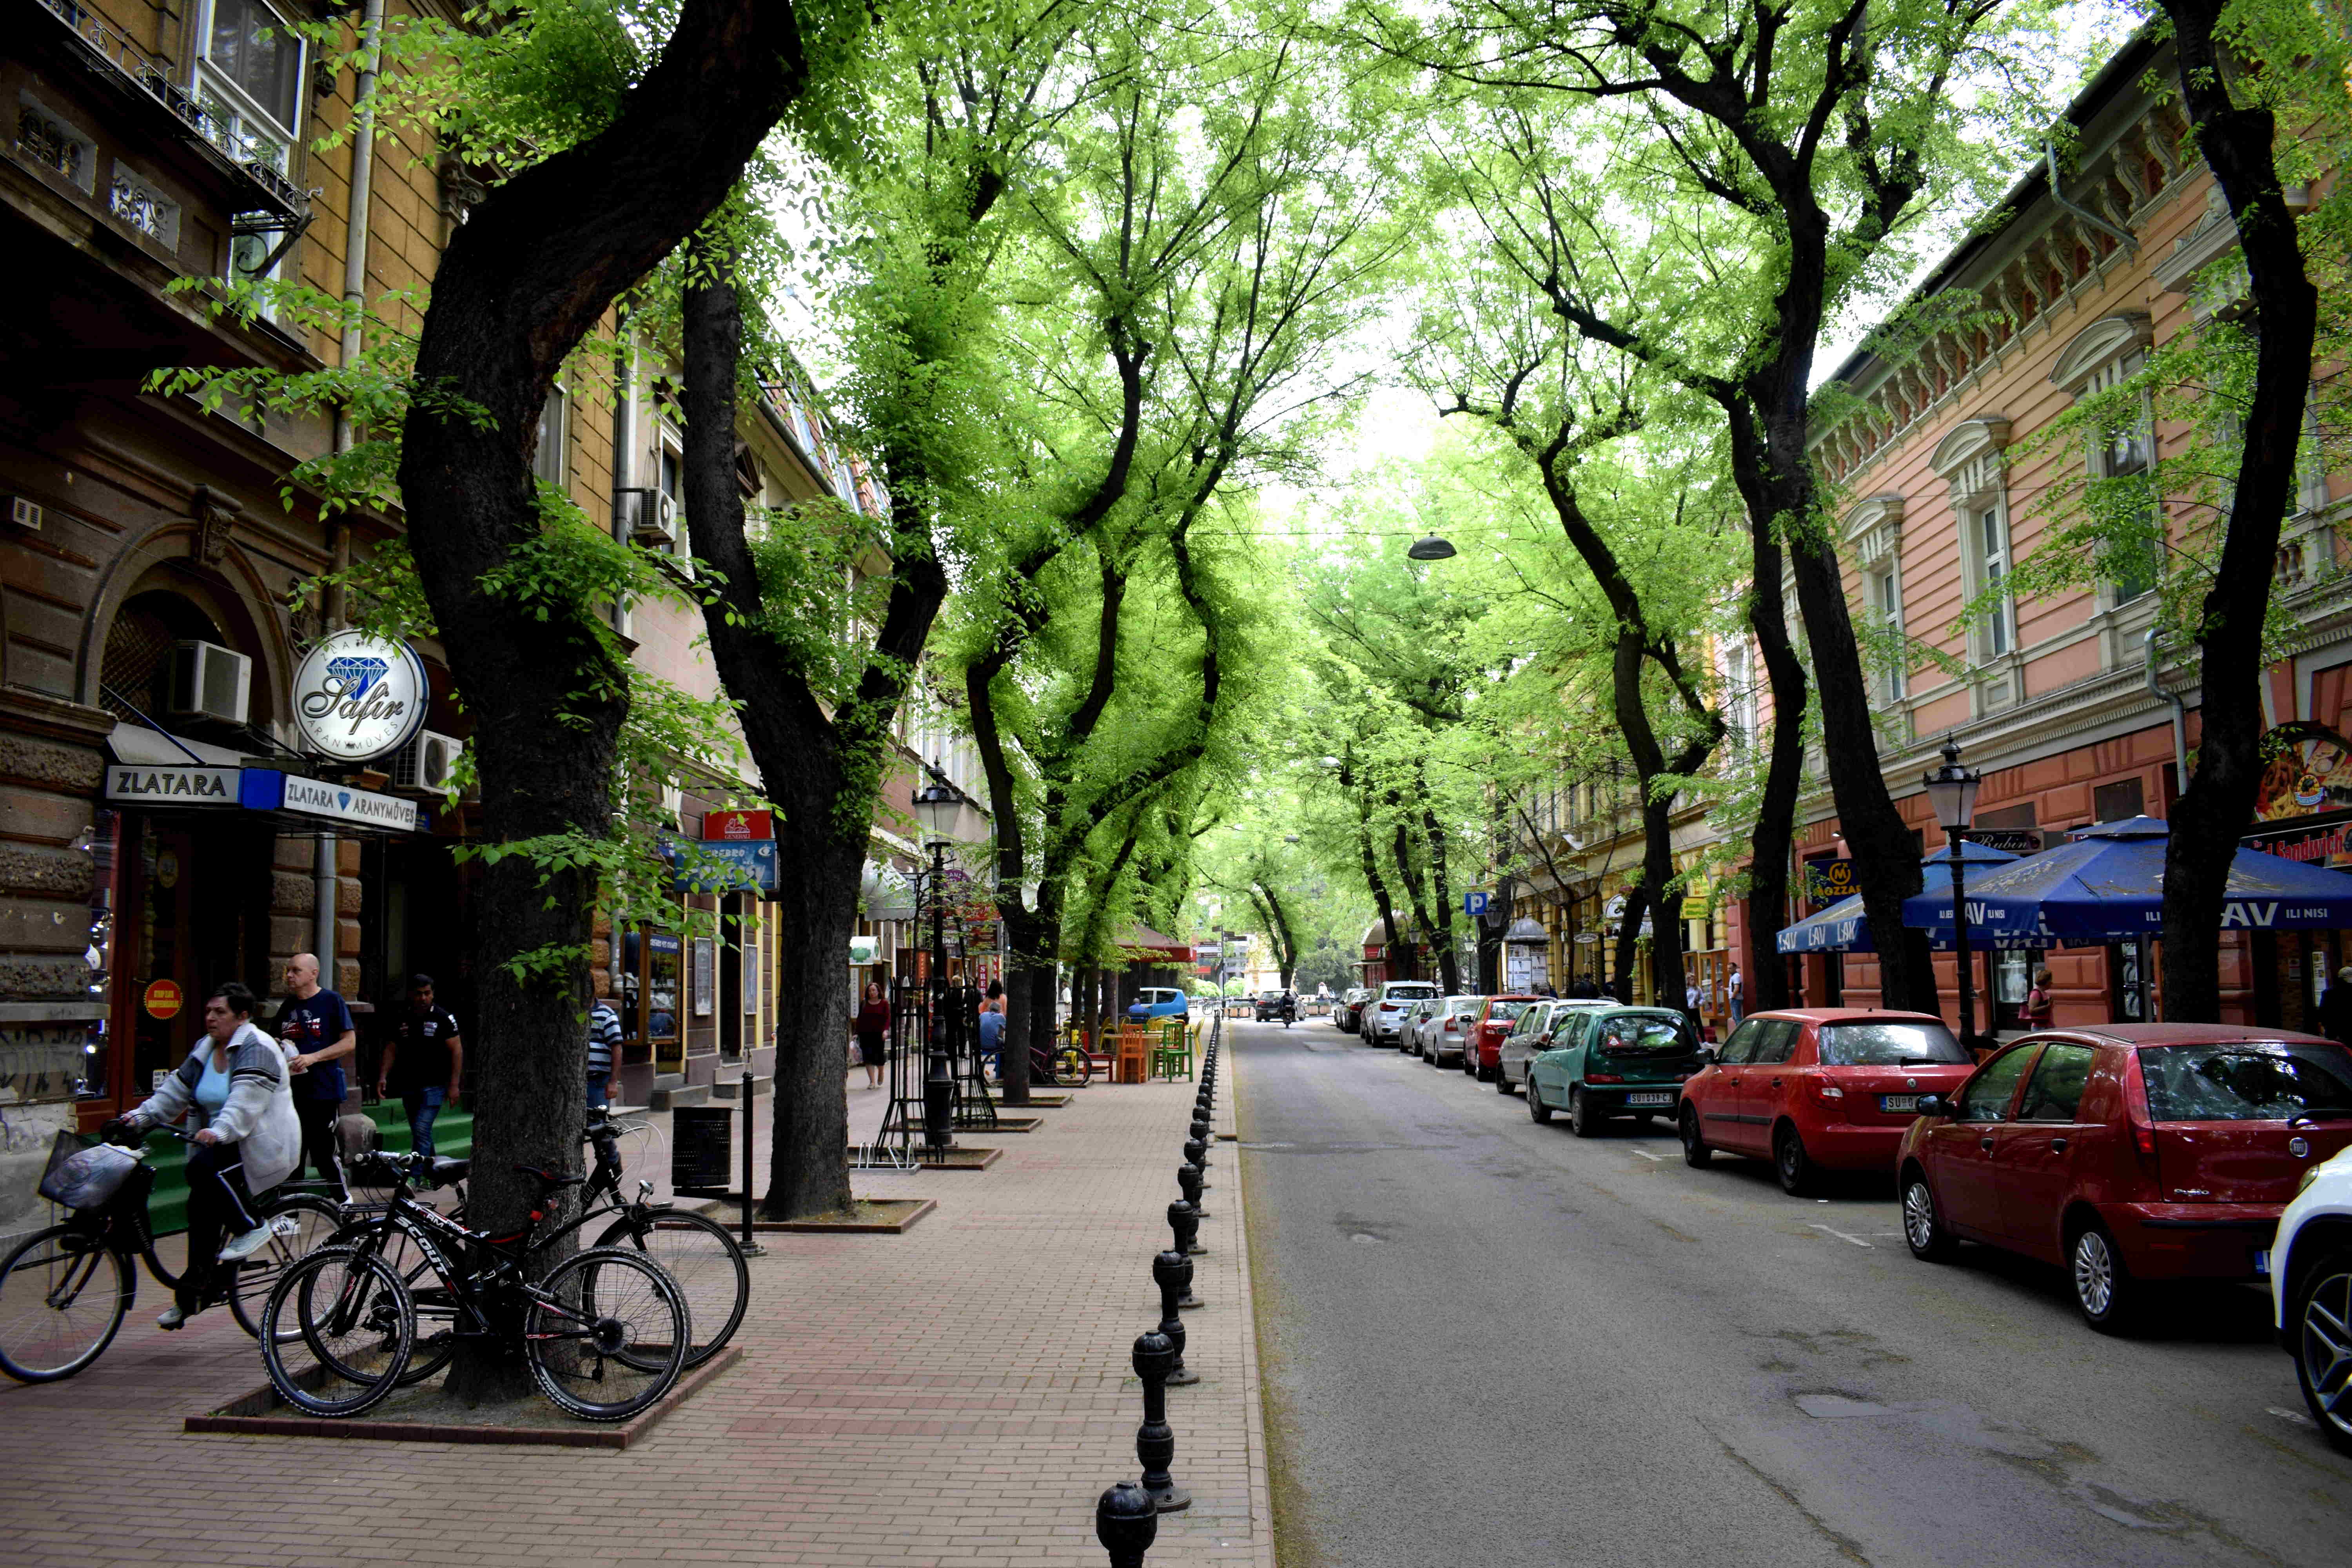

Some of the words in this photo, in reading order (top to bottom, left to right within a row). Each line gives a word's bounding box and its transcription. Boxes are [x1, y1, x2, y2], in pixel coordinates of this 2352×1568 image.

[321, 639, 396, 663] ZLATARA
[301, 674, 404, 735] Safir
[117, 771, 226, 797] ZLATARA
[287, 784, 334, 808] ZLATARA
[705, 849, 744, 857] REBRO
[1971, 834, 2026, 849] Rubin
[2276, 828, 2343, 862] Sandwich
[1471, 895, 1483, 913] P
[1964, 902, 1985, 924] AV
[2220, 902, 2279, 927] AV
[2286, 909, 2300, 918] ILI
[2303, 908, 2328, 918] NISI
[2145, 912, 2161, 921] ILI
[1779, 931, 1797, 951] LAV
[1808, 926, 1826, 946] LAV
[1888, 1098, 1900, 1108] SU
[394, 1216, 449, 1275] SCOUT
